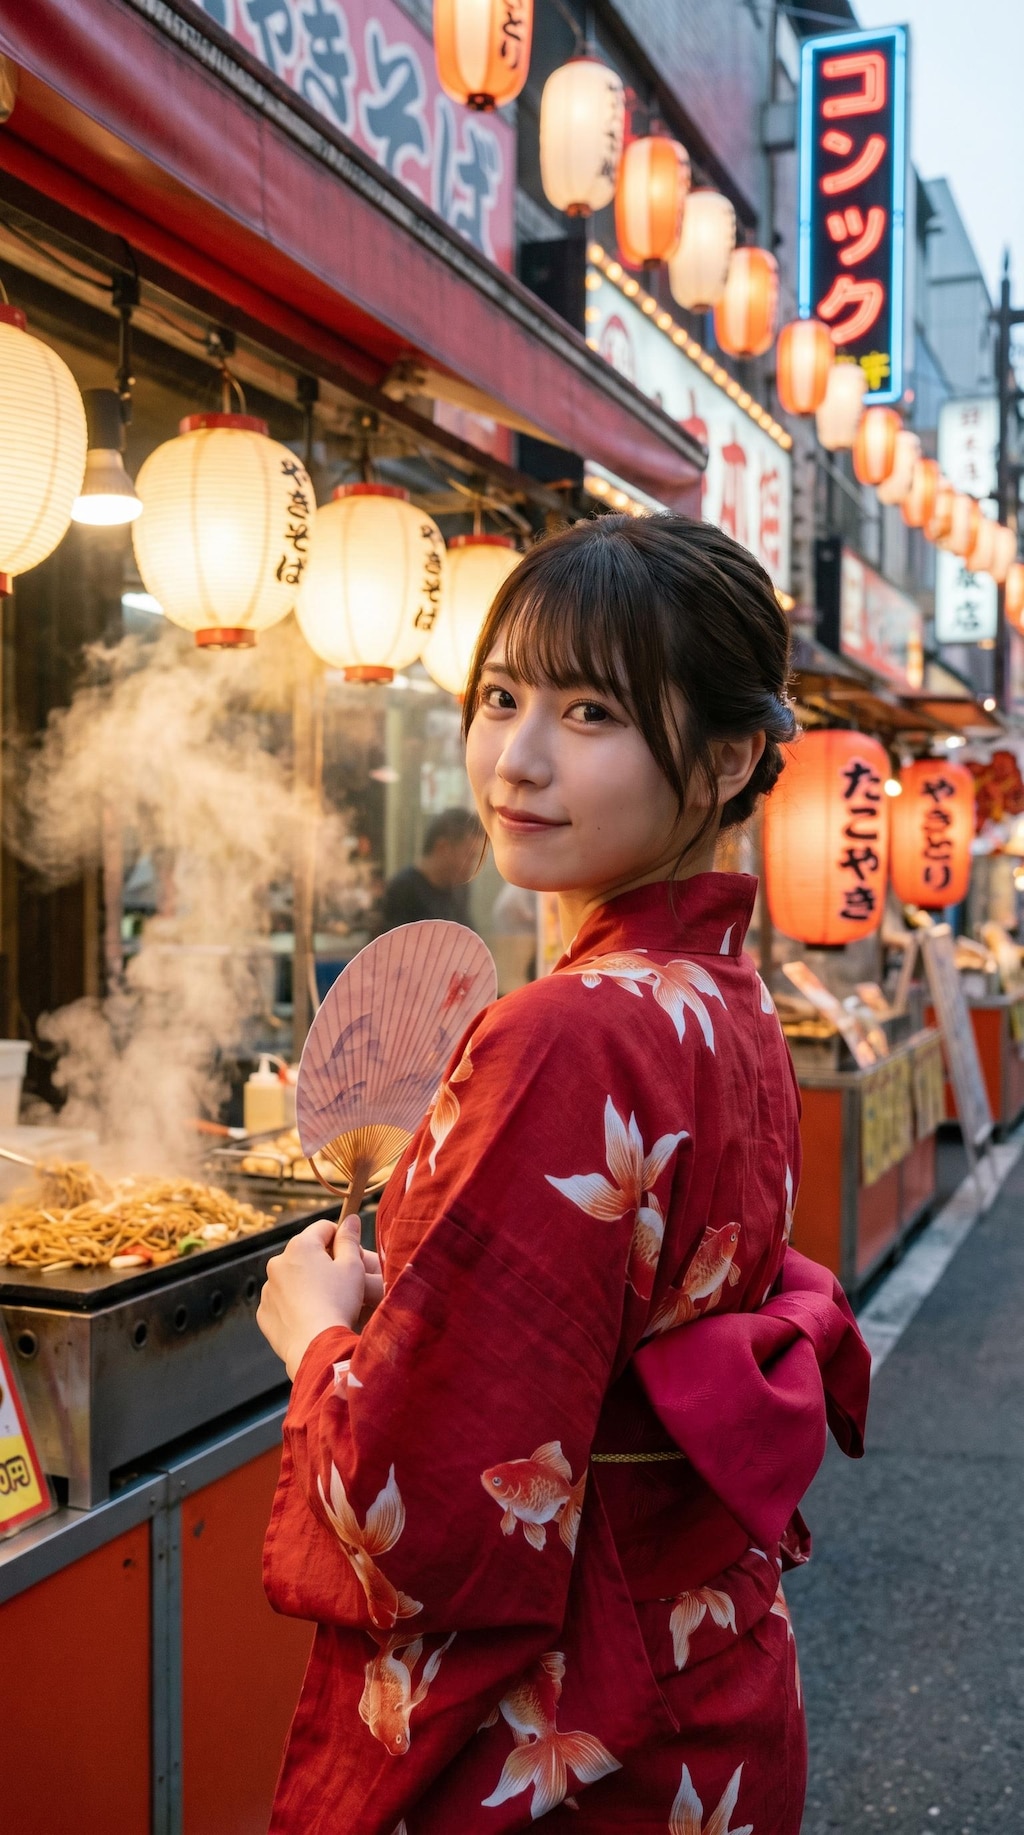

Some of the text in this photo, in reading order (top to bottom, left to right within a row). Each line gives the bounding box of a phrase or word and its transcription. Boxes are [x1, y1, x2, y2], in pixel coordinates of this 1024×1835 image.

[838, 762, 882, 921] たこやき
[922, 777, 956, 890] やきとり
